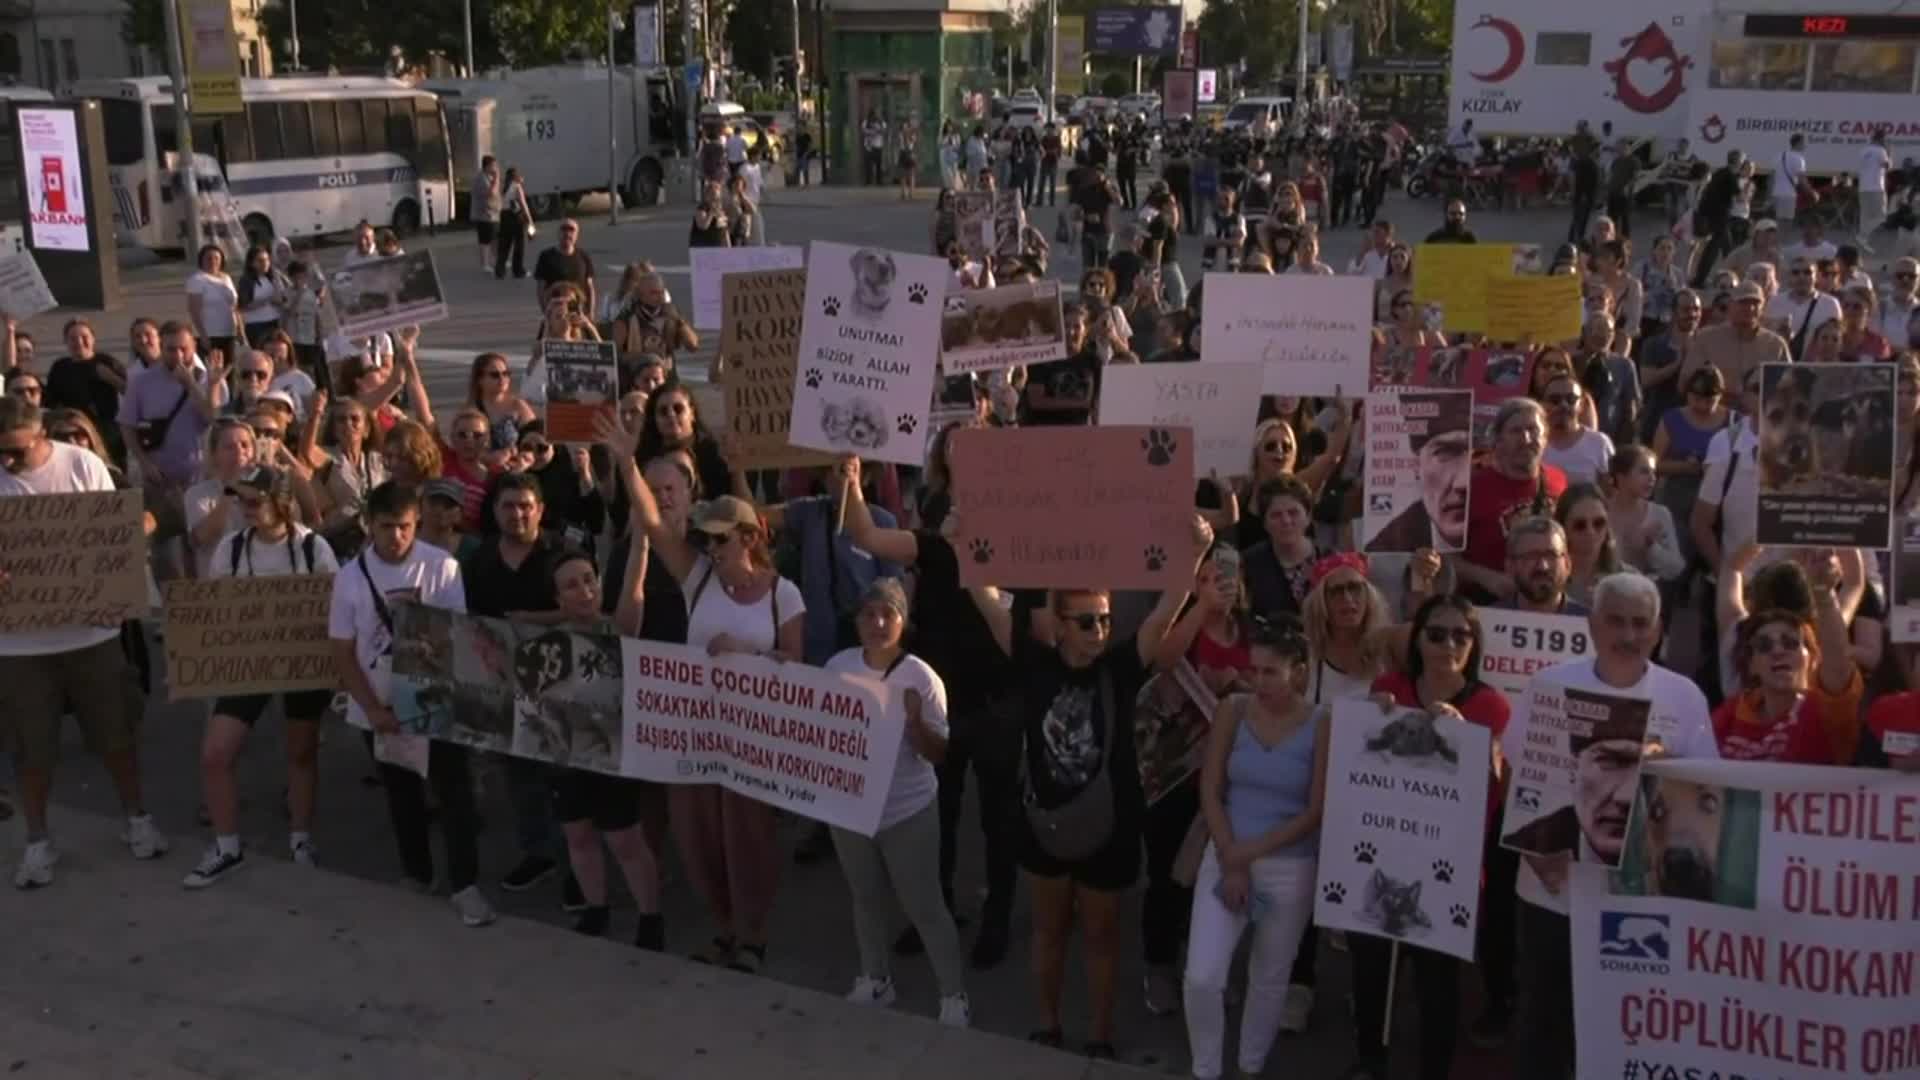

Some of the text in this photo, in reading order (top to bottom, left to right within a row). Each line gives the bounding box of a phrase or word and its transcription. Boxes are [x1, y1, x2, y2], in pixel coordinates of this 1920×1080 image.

[1462, 98, 1522, 113] KIZILAY
[526, 120, 555, 140] T93
[31, 212, 87, 226] AKBANK
[839, 326, 904, 347] UNUTMA!
[867, 357, 911, 377] ALLAH
[640, 655, 871, 729] BENDE ÇOCUĞUM AMA,
[636, 689, 869, 761] SOKAKTAKİ HAYVANLARDAN DEĞİL
[636, 723, 866, 799] BAŞIBOŞ İNSANLARDAN KORKUYORUM!
[1350, 771, 1460, 803] KANLI YASAYA
[1362, 812, 1397, 830] DUR
[1400, 817, 1420, 833] DE
[1772, 785, 1920, 845] KEDİLE
[1782, 856, 1898, 922] ÖLÜM
[1600, 959, 1670, 976] SOHAYKO
[1686, 926, 1915, 999] KAN KOKAN
[1619, 988, 1848, 1072] ÇÖPLÜKLER
